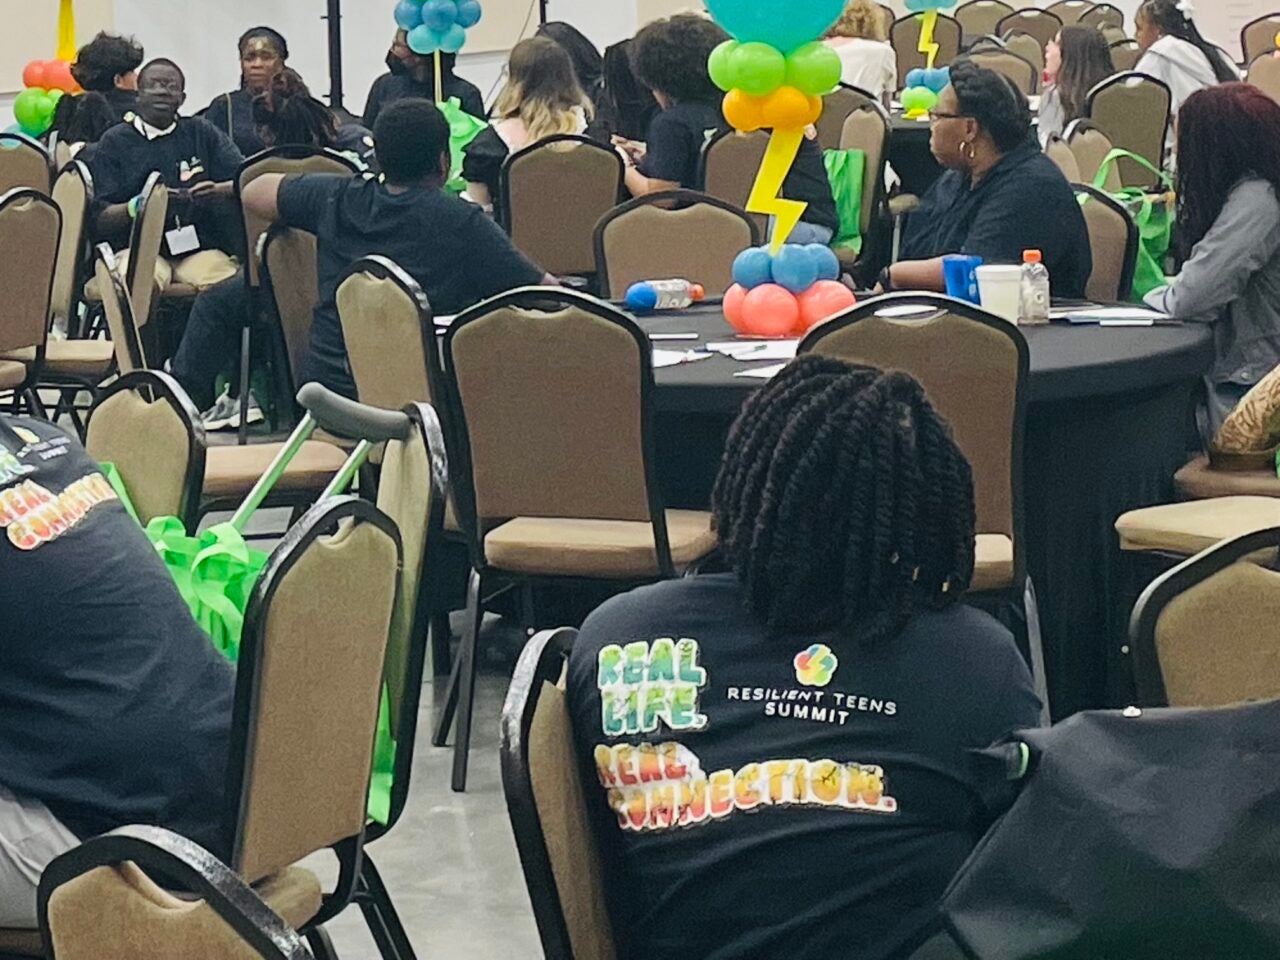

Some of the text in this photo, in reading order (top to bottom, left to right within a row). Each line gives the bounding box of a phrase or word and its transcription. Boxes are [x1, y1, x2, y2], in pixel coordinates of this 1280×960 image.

[598, 638, 706, 689] REAL
[601, 686, 707, 735] LIFE.
[727, 687, 897, 715] RESILIENT TEENS
[765, 702, 850, 725] SUMMIT
